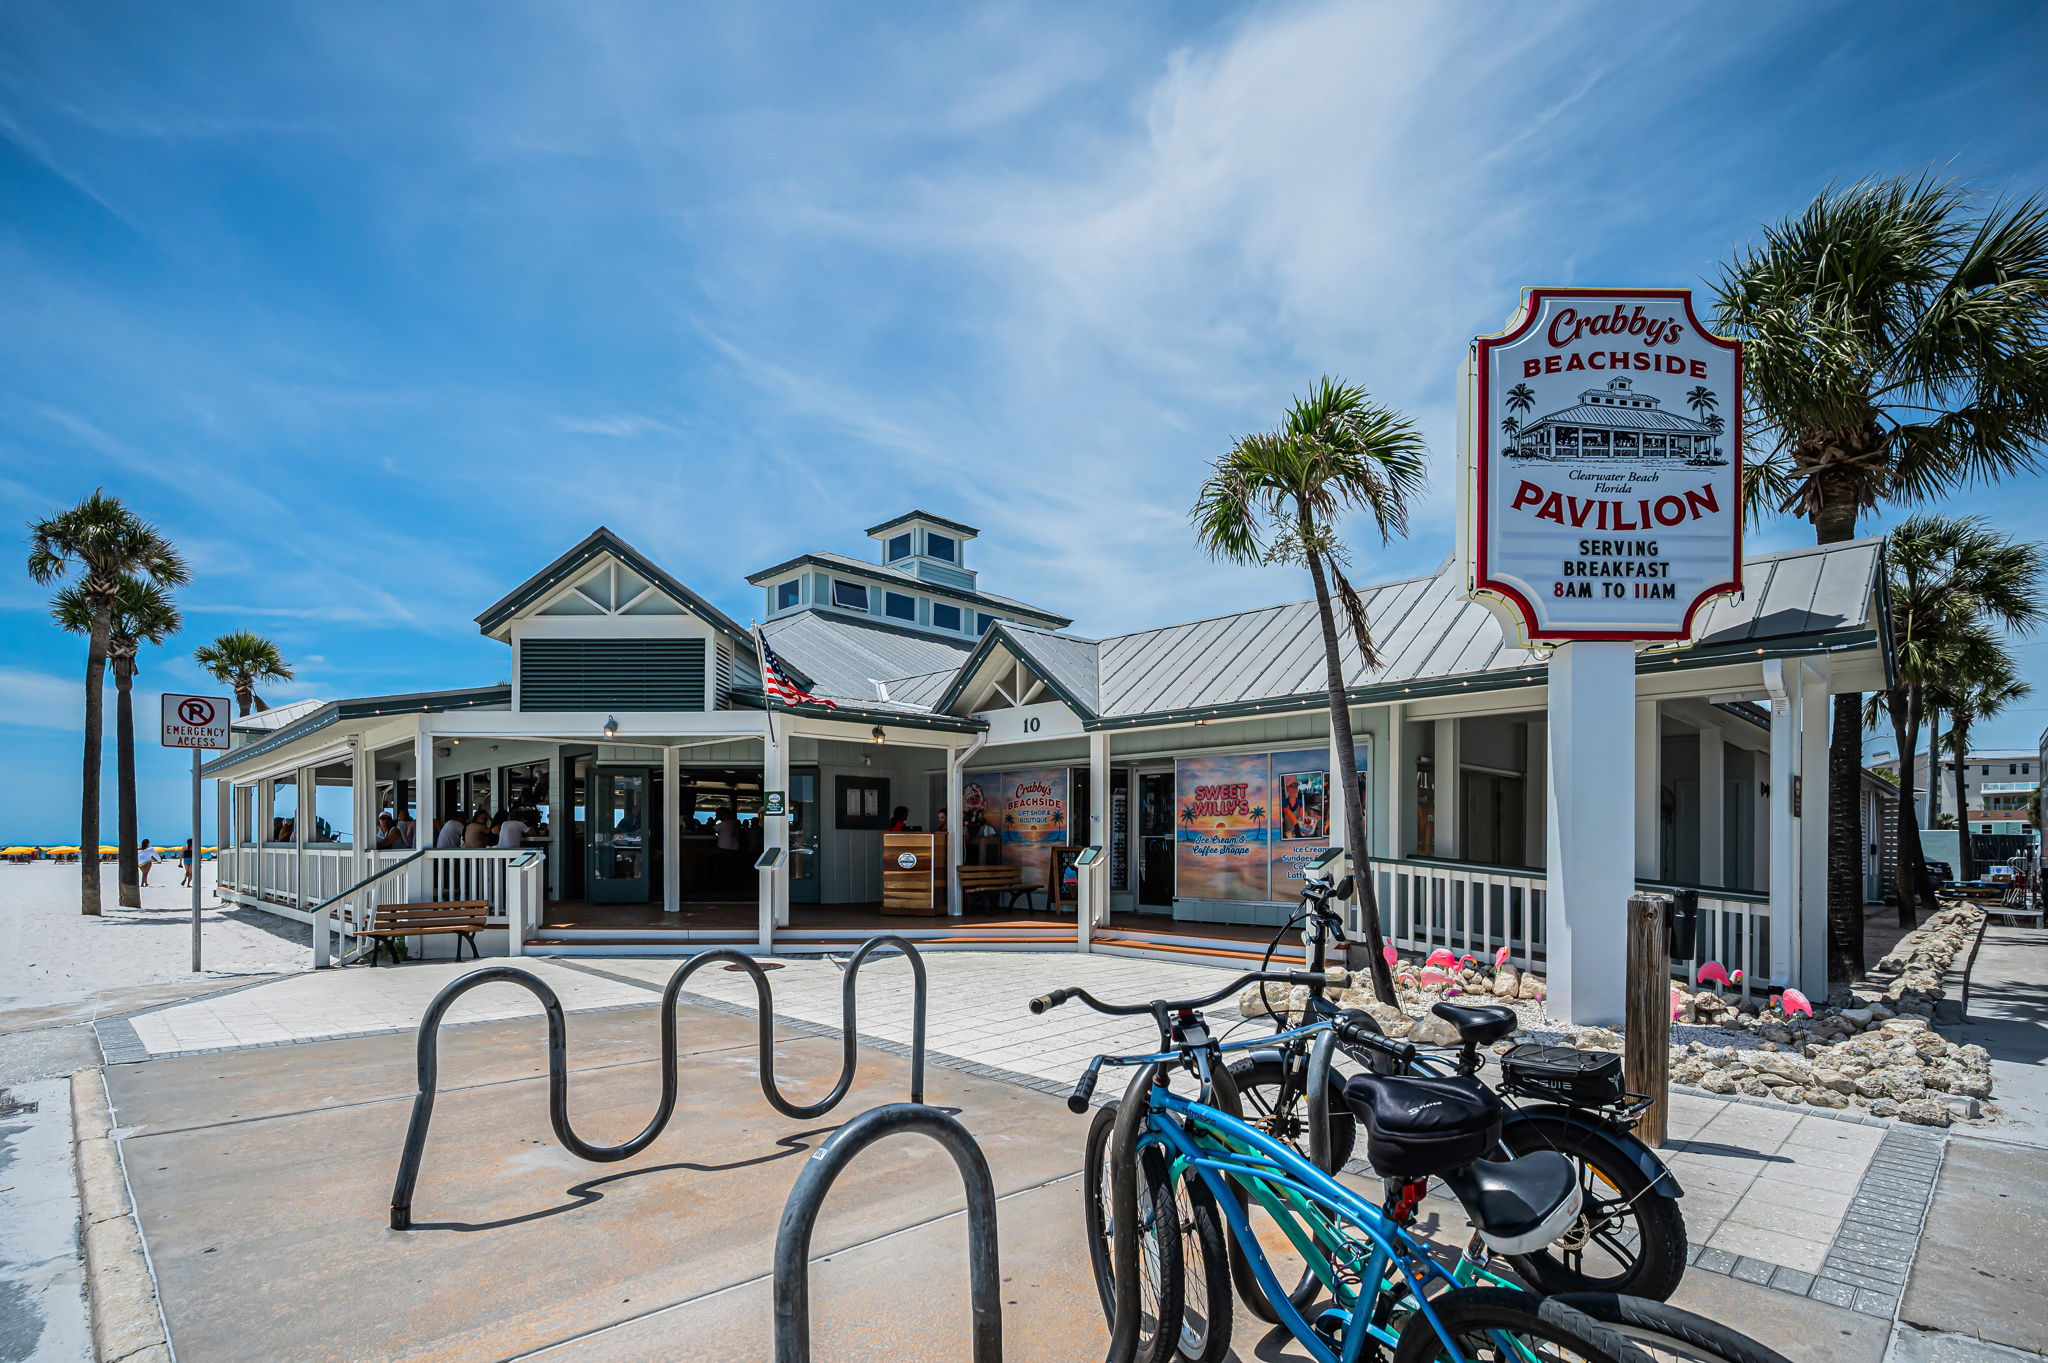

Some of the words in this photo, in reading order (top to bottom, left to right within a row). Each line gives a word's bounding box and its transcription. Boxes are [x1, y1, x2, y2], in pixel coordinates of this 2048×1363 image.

[1547, 304, 1684, 349] Crabby's
[1523, 351, 1708, 379] BEACHSIDE
[1568, 470, 1626, 482] Clearwater
[1628, 470, 1659, 483] Beach
[1594, 483, 1632, 494] Florida
[1510, 479, 1720, 531] PAVILION
[1579, 540, 1659, 557] SERVING
[1563, 560, 1670, 578] BREAKFAST
[1553, 581, 1592, 598] 8AM
[1602, 582, 1625, 598] TO
[166, 725, 225, 737] EMERGENCY
[1023, 717, 1040, 733] 10
[177, 736, 215, 747] ACCESS
[1015, 781, 1052, 799] Crabby's
[1195, 783, 1248, 801] SWEET
[1008, 798, 1061, 810] BEACHSIDE
[1193, 799, 1249, 817] WILLY'S
[1195, 835, 1209, 845] Ice
[1211, 835, 1237, 845] Cream
[1193, 845, 1218, 857] Coffee
[1220, 845, 1250, 855] Shoppe
